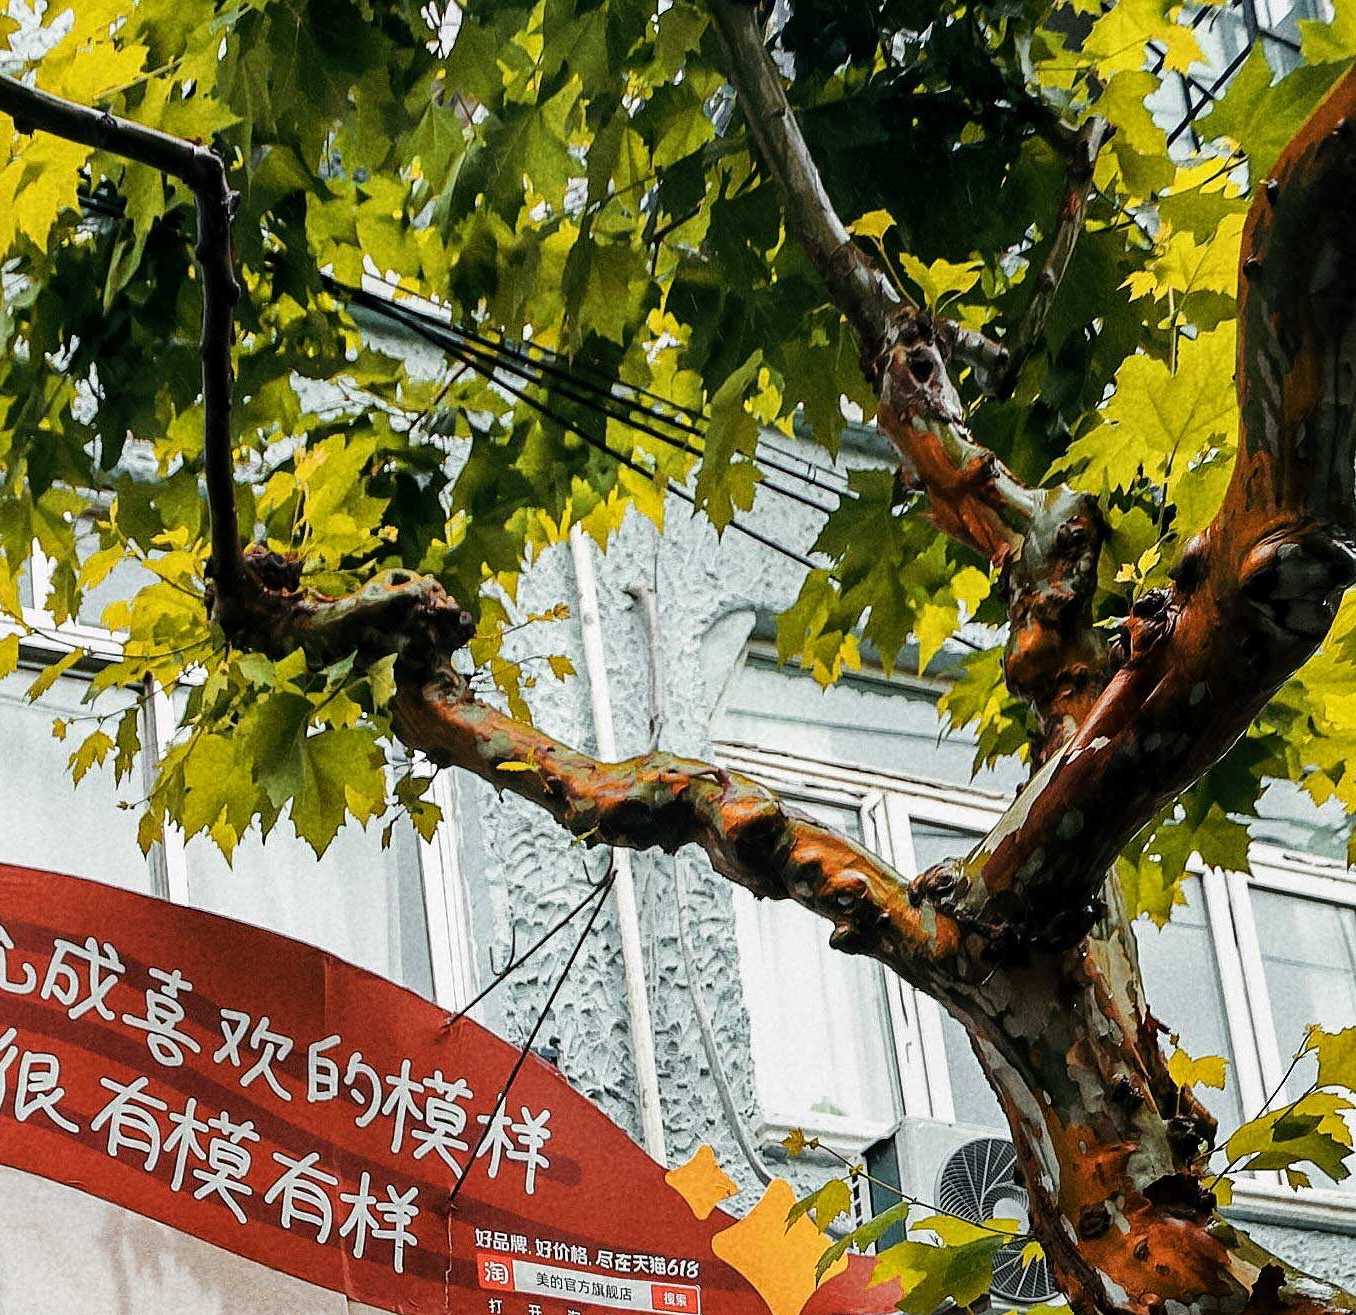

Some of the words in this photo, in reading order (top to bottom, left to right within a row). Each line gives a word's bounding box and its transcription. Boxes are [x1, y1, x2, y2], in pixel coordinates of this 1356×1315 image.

[484, 1261, 509, 1285] 淘
[536, 1271, 632, 1301] 美的官方旗舰店
[664, 1292, 688, 1307] 搜索
